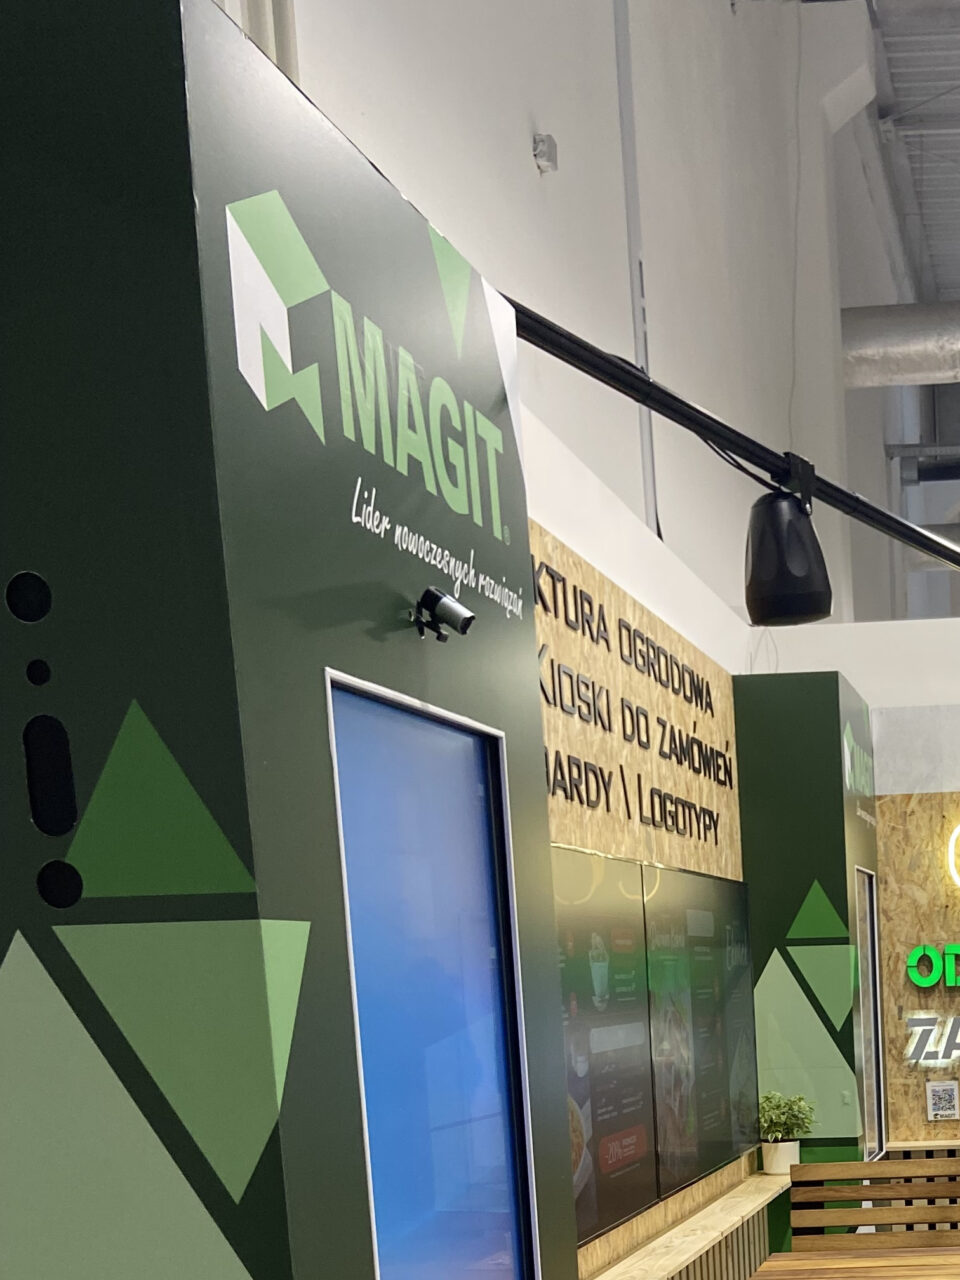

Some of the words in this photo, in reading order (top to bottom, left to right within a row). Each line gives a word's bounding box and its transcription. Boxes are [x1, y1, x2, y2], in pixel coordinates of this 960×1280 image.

[331, 290, 503, 541] MAGIT
[352, 476, 391, 539] Lider
[394, 523, 477, 599] nowoczesnych
[618, 618, 714, 717] OGRODOWA
[620, 697, 650, 750] DO
[656, 721, 734, 789] ZAMÓWIEŃ
[544, 746, 613, 813] ARDY
[637, 773, 720, 846] LOGOTYPY
